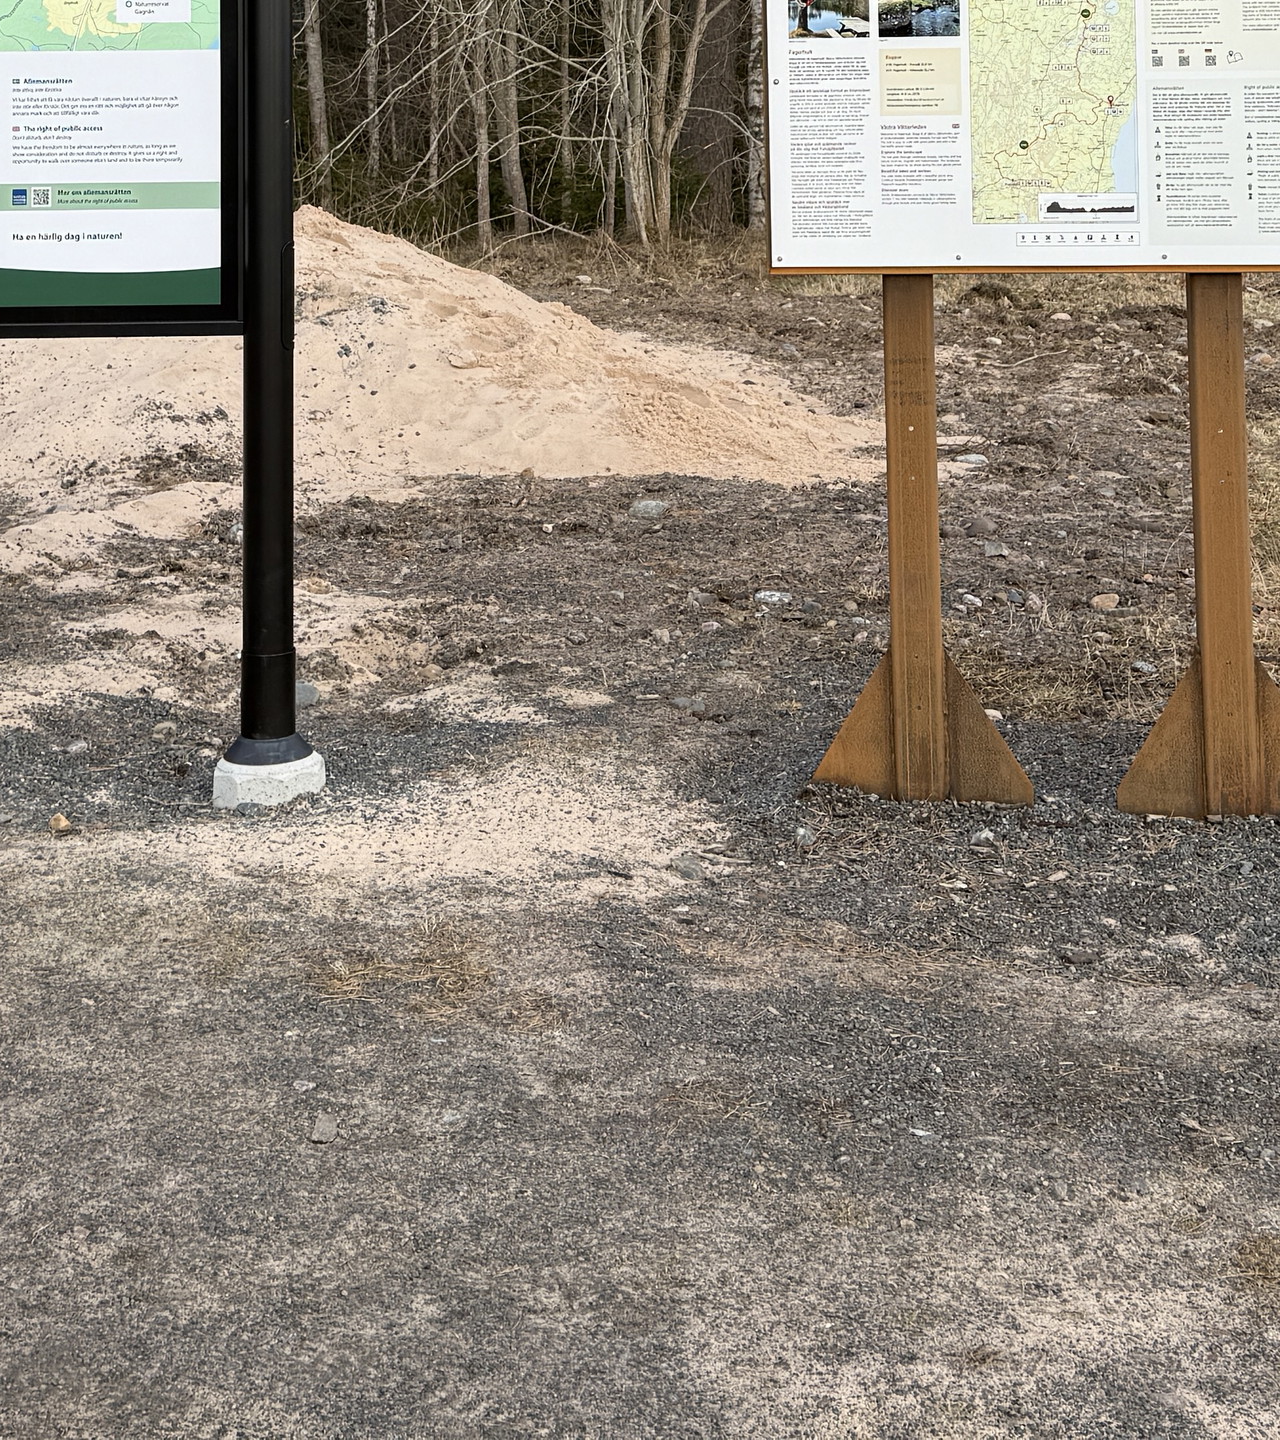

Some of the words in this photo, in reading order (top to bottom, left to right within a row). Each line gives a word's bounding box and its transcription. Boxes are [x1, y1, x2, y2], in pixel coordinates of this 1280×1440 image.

[36, 125, 52, 133] right
[38, 232, 62, 242] härlig
[64, 232, 80, 242] dag
